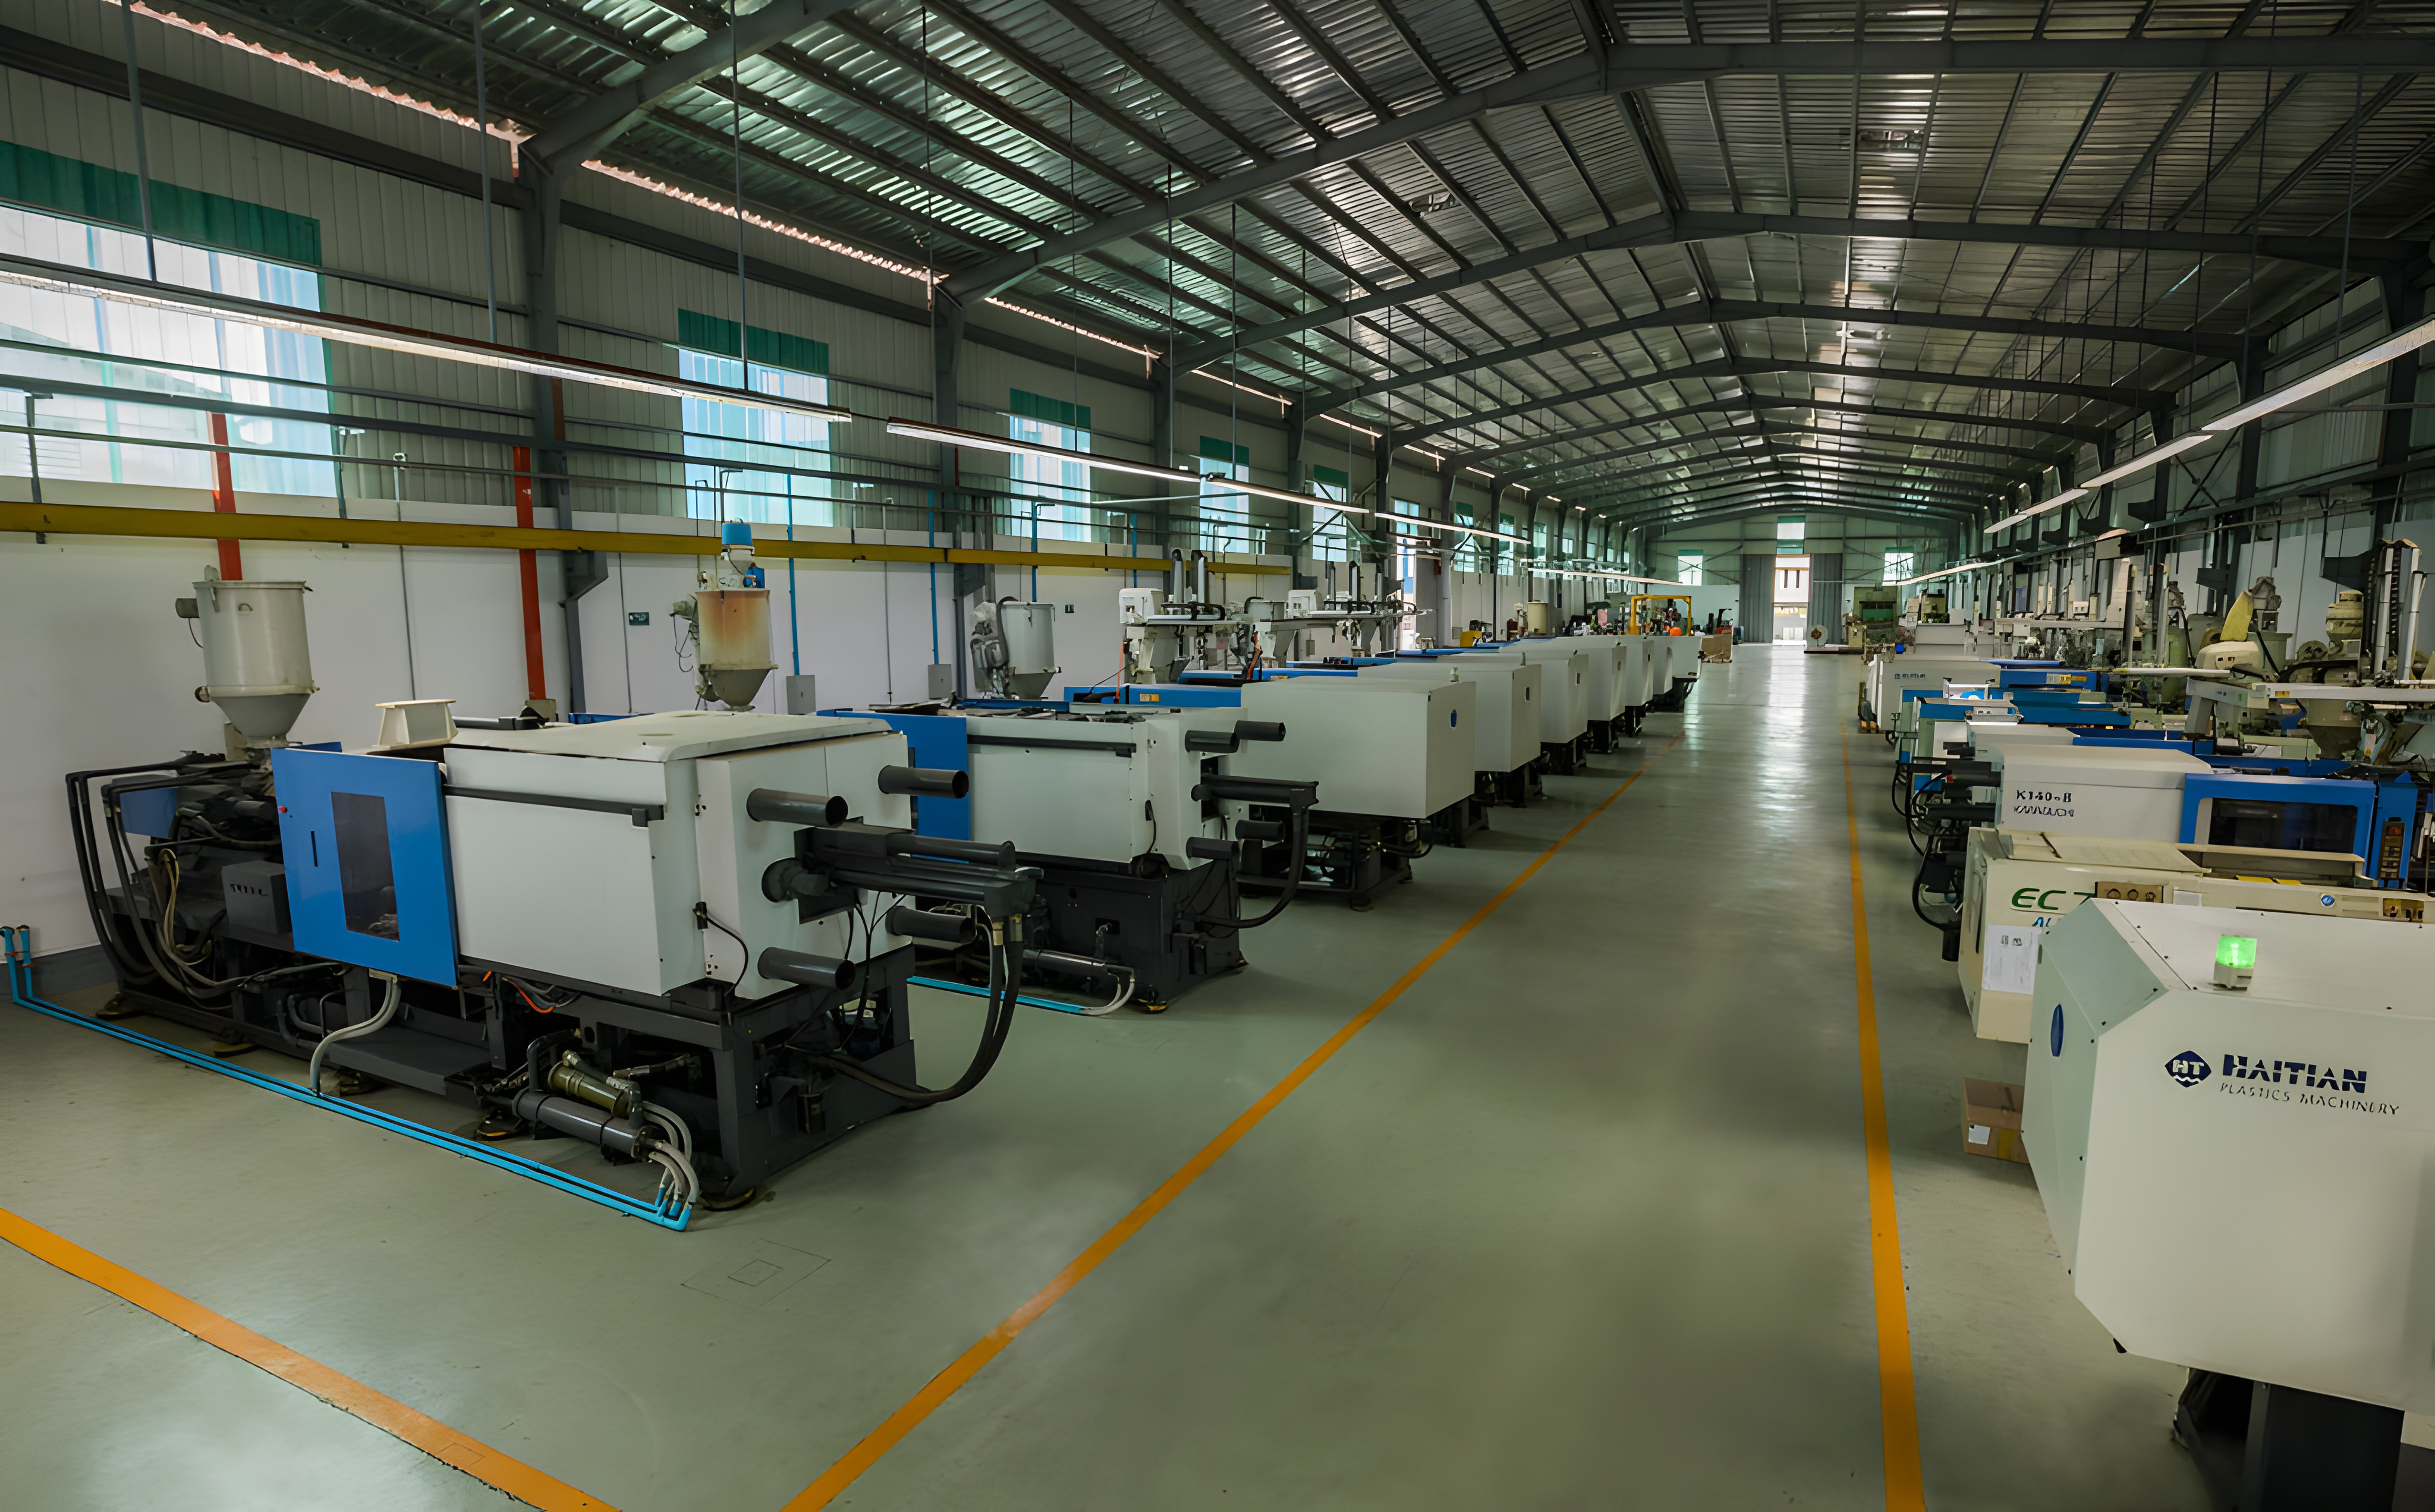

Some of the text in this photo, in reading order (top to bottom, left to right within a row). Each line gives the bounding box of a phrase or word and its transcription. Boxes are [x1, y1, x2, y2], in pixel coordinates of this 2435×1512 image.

[2172, 1059, 2204, 1075] HT
[2223, 1054, 2367, 1094] HAITIAN
[2220, 1082, 2399, 1115] PLASTICS MACHINERY
